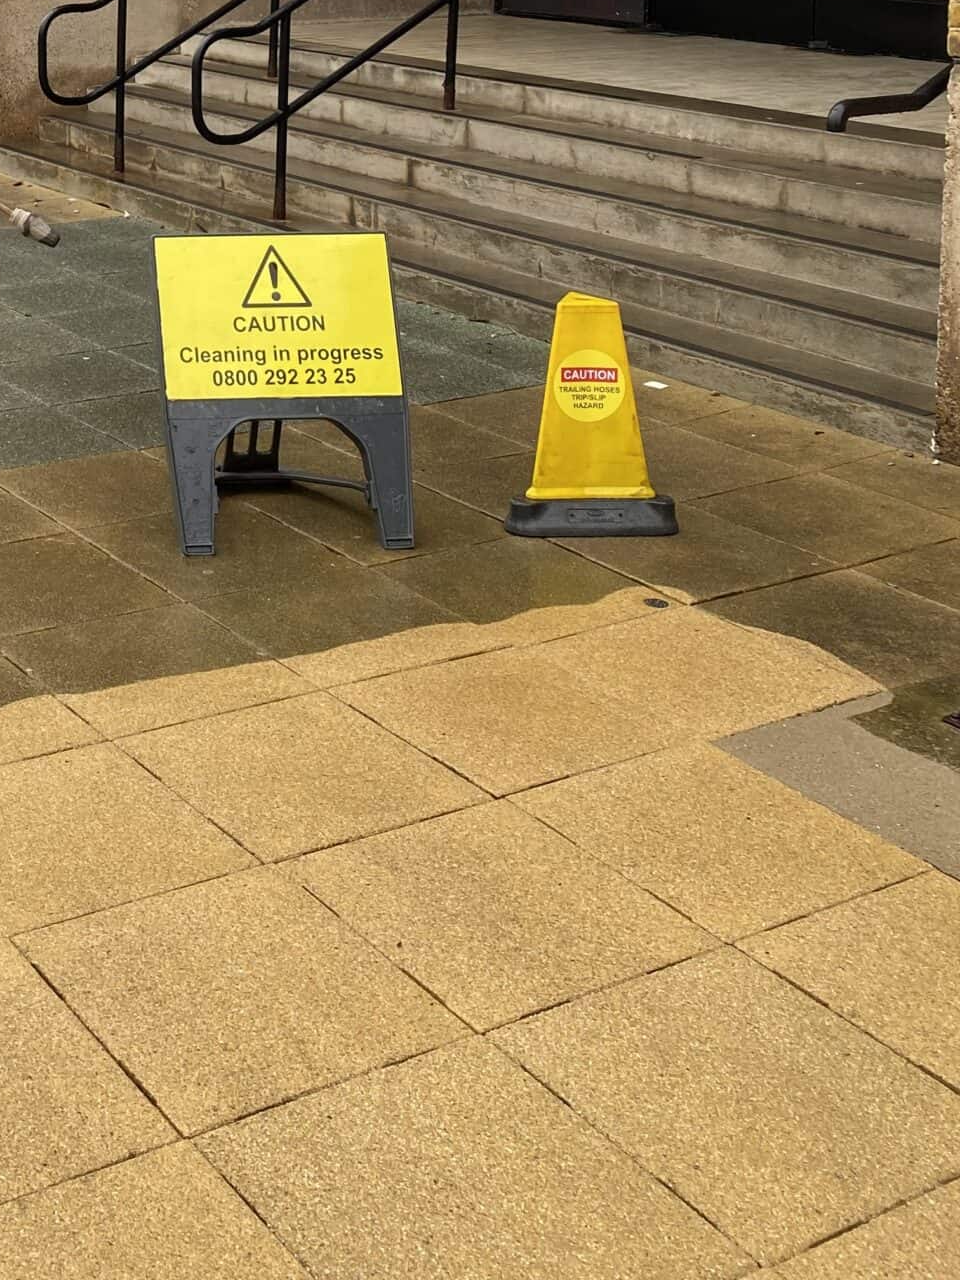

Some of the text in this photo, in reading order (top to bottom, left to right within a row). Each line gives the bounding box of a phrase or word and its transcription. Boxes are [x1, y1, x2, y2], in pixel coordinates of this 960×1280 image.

[233, 315, 326, 332] CAUTION
[180, 345, 384, 366] Cleaning in progress
[212, 368, 356, 386] 0800 292 23 25
[563, 370, 616, 380] CAUTION
